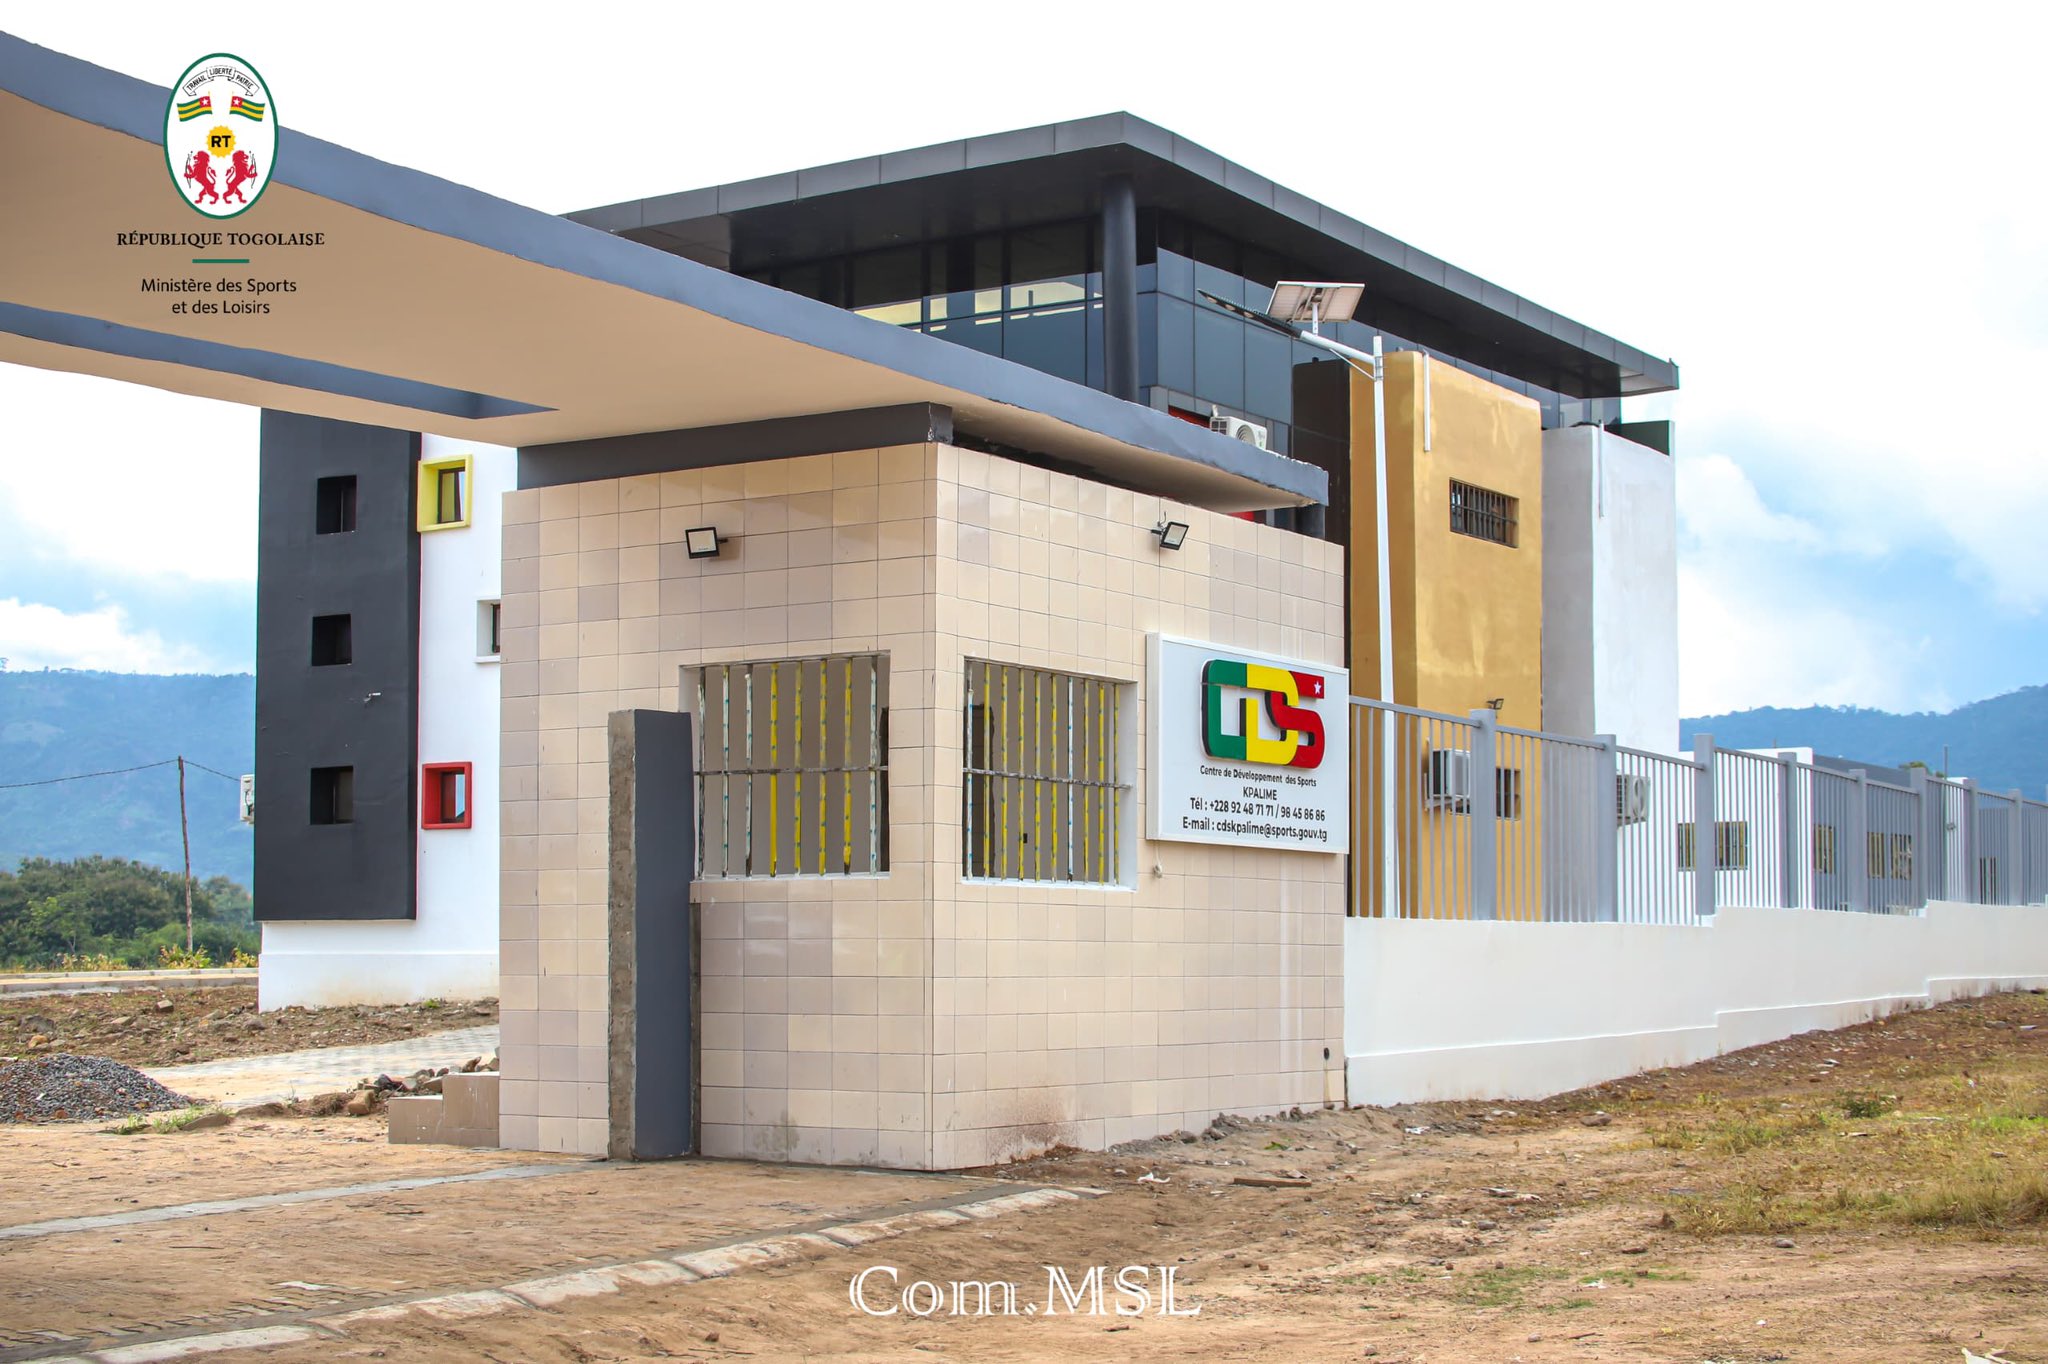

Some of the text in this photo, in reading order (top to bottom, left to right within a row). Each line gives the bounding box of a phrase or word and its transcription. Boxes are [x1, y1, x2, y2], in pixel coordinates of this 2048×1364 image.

[1200, 765, 1317, 787] Centre de Développement des Sports
[1243, 786, 1277, 800] KPALIME
[1190, 797, 1203, 810] Tél
[1210, 800, 1229, 813] +228
[1231, 801, 1241, 813] 92
[1243, 803, 1254, 815] 48
[1256, 804, 1264, 816] 71
[1266, 805, 1274, 817] 71
[1281, 806, 1291, 818] 98
[1293, 807, 1302, 819] 45
[1304, 808, 1314, 820] 86
[1316, 809, 1325, 821] 86
[1183, 816, 1210, 830] E-mail
[1216, 819, 1327, 842] cdskpalime@sports.gouv.tg
